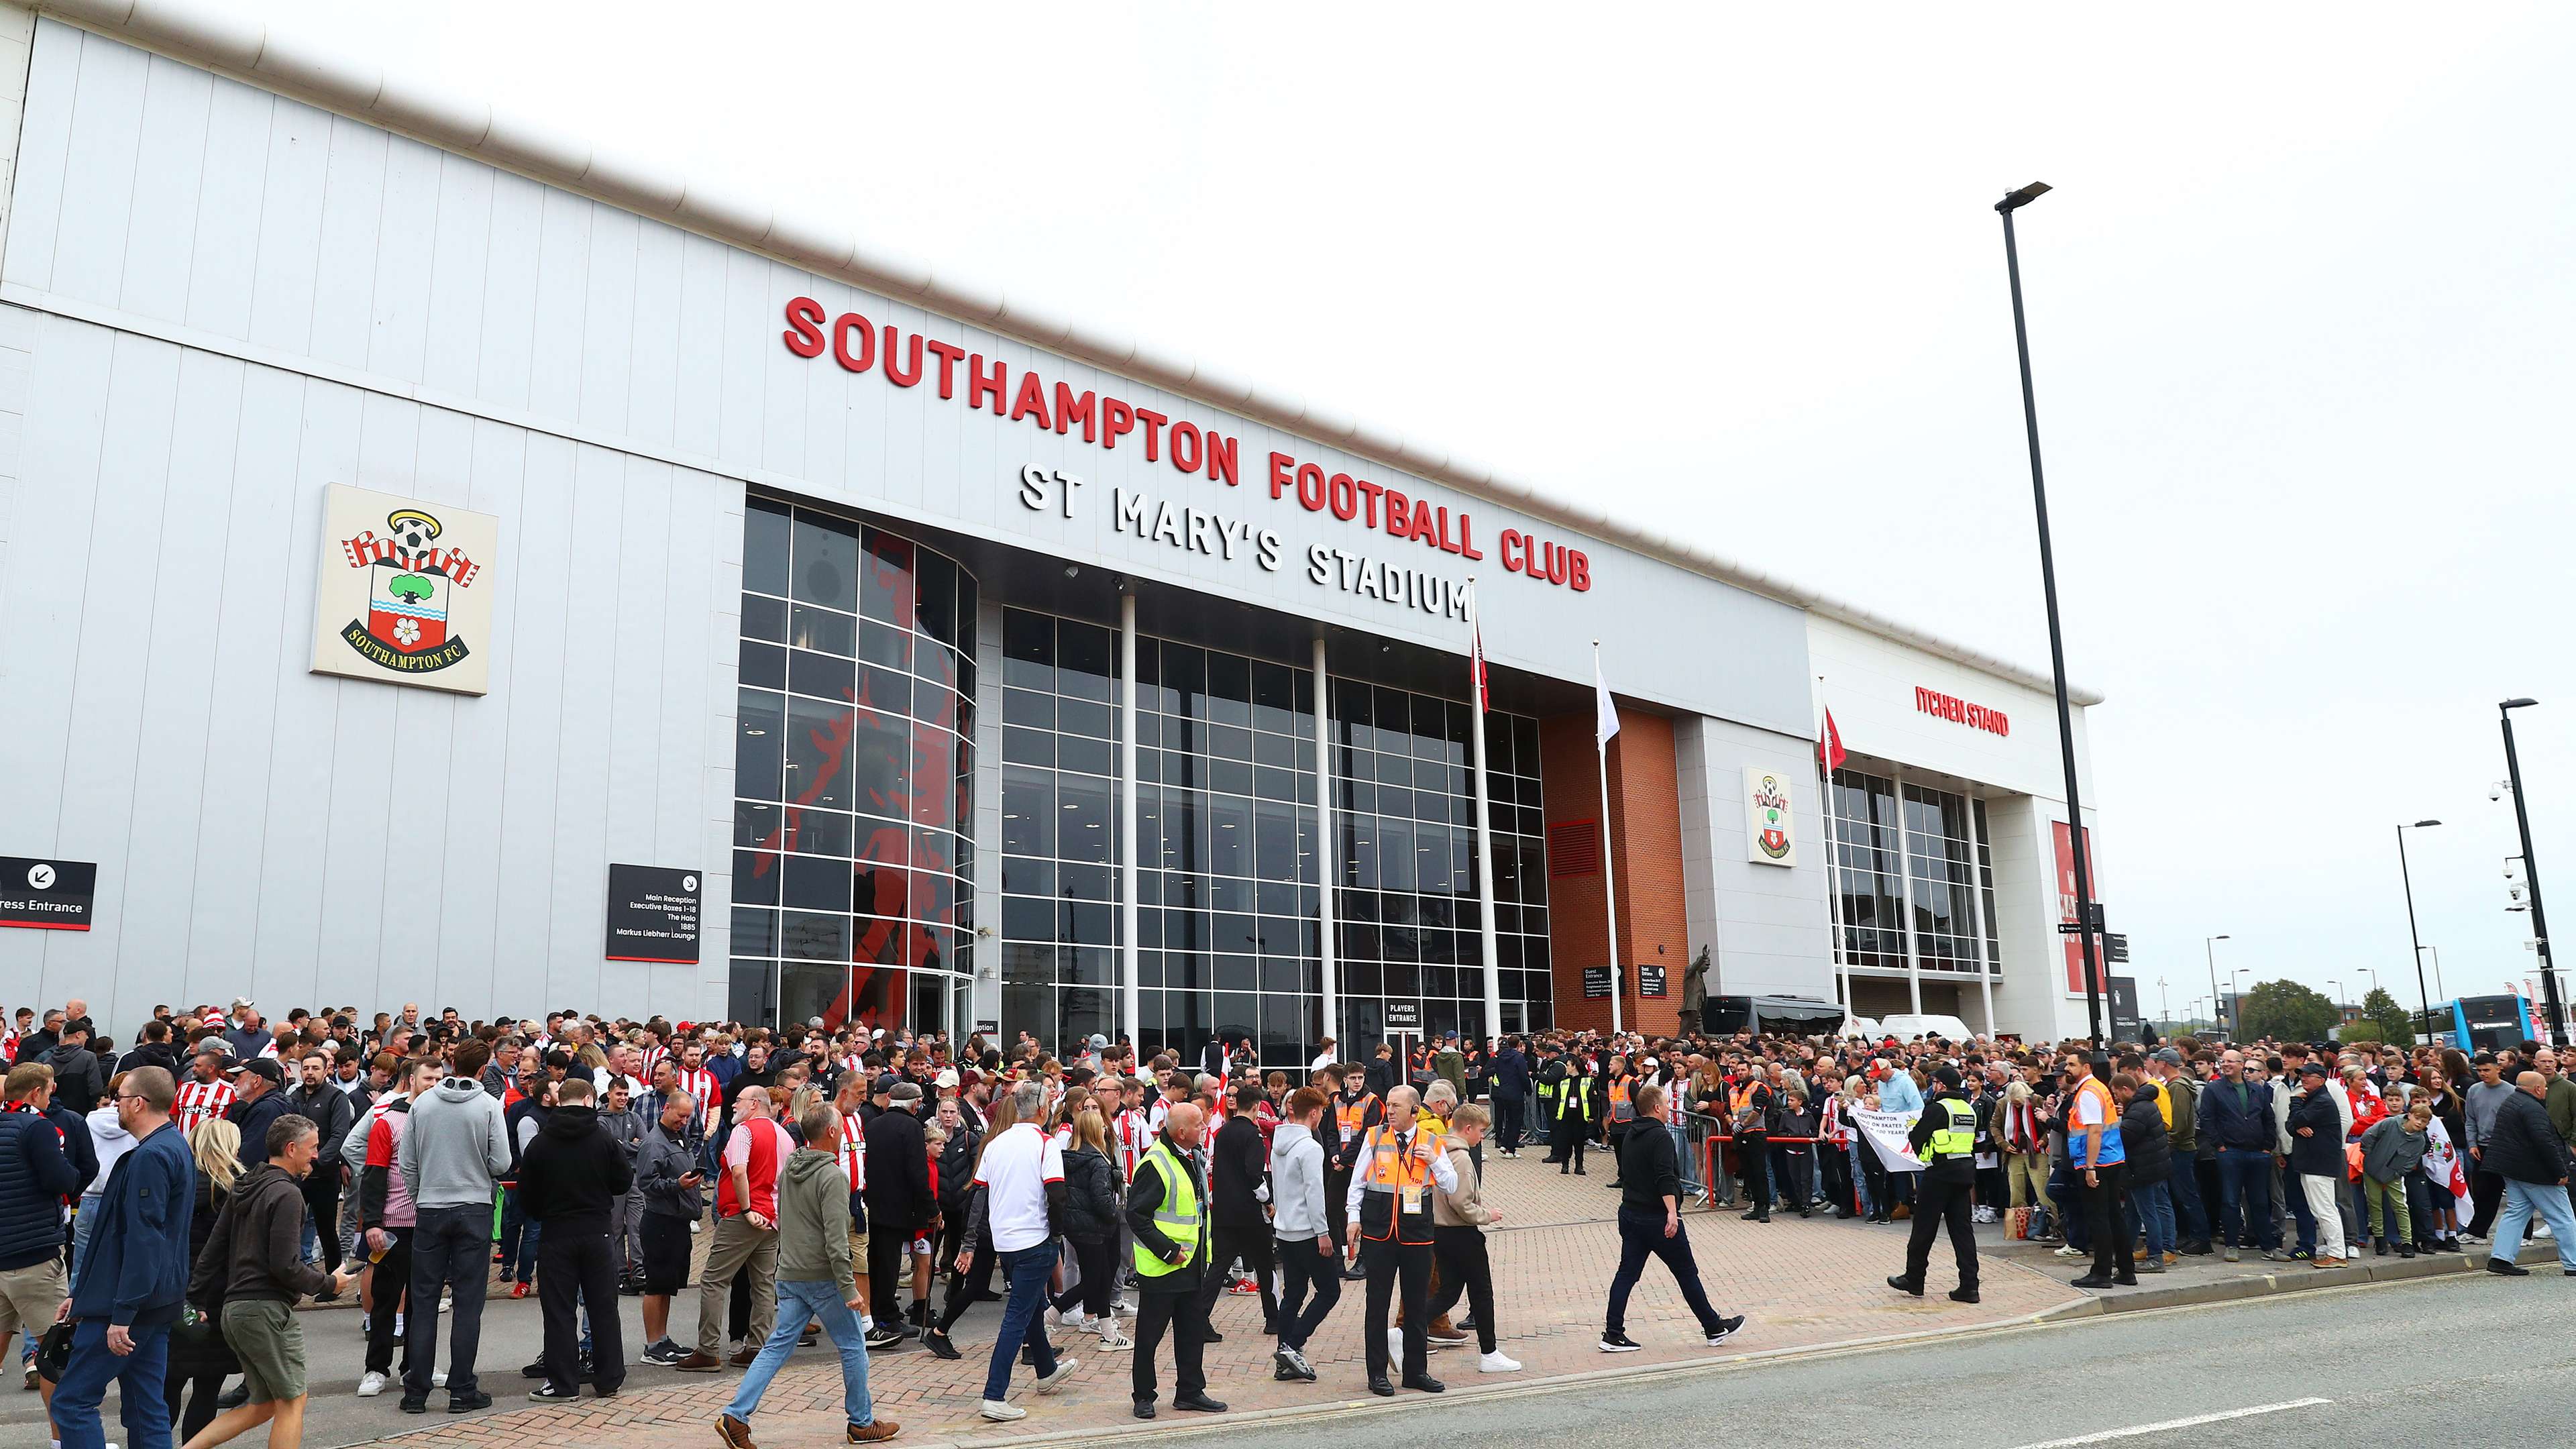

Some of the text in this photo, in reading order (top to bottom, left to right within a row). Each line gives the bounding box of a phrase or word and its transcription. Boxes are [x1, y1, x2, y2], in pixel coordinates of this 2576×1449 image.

[783, 296, 1592, 592] SOUTHAMPTON FOOTBALL CLUB
[1020, 462, 1471, 622] ST MARY'S STADIUM
[347, 629, 462, 669] SOUTHAMPTON FC
[1915, 686, 2010, 737] ITCHEN STAND
[0, 899, 83, 913] ress Entrance
[645, 894, 697, 905] Main Reception
[630, 901, 697, 913] Executive Boxes 1-18
[667, 913, 680, 921] The
[616, 928, 696, 941] Markus Liebherr Lounge
[1390, 1004, 1415, 1012] PLAYERS
[1389, 1014, 1417, 1022] ENTRANCE
